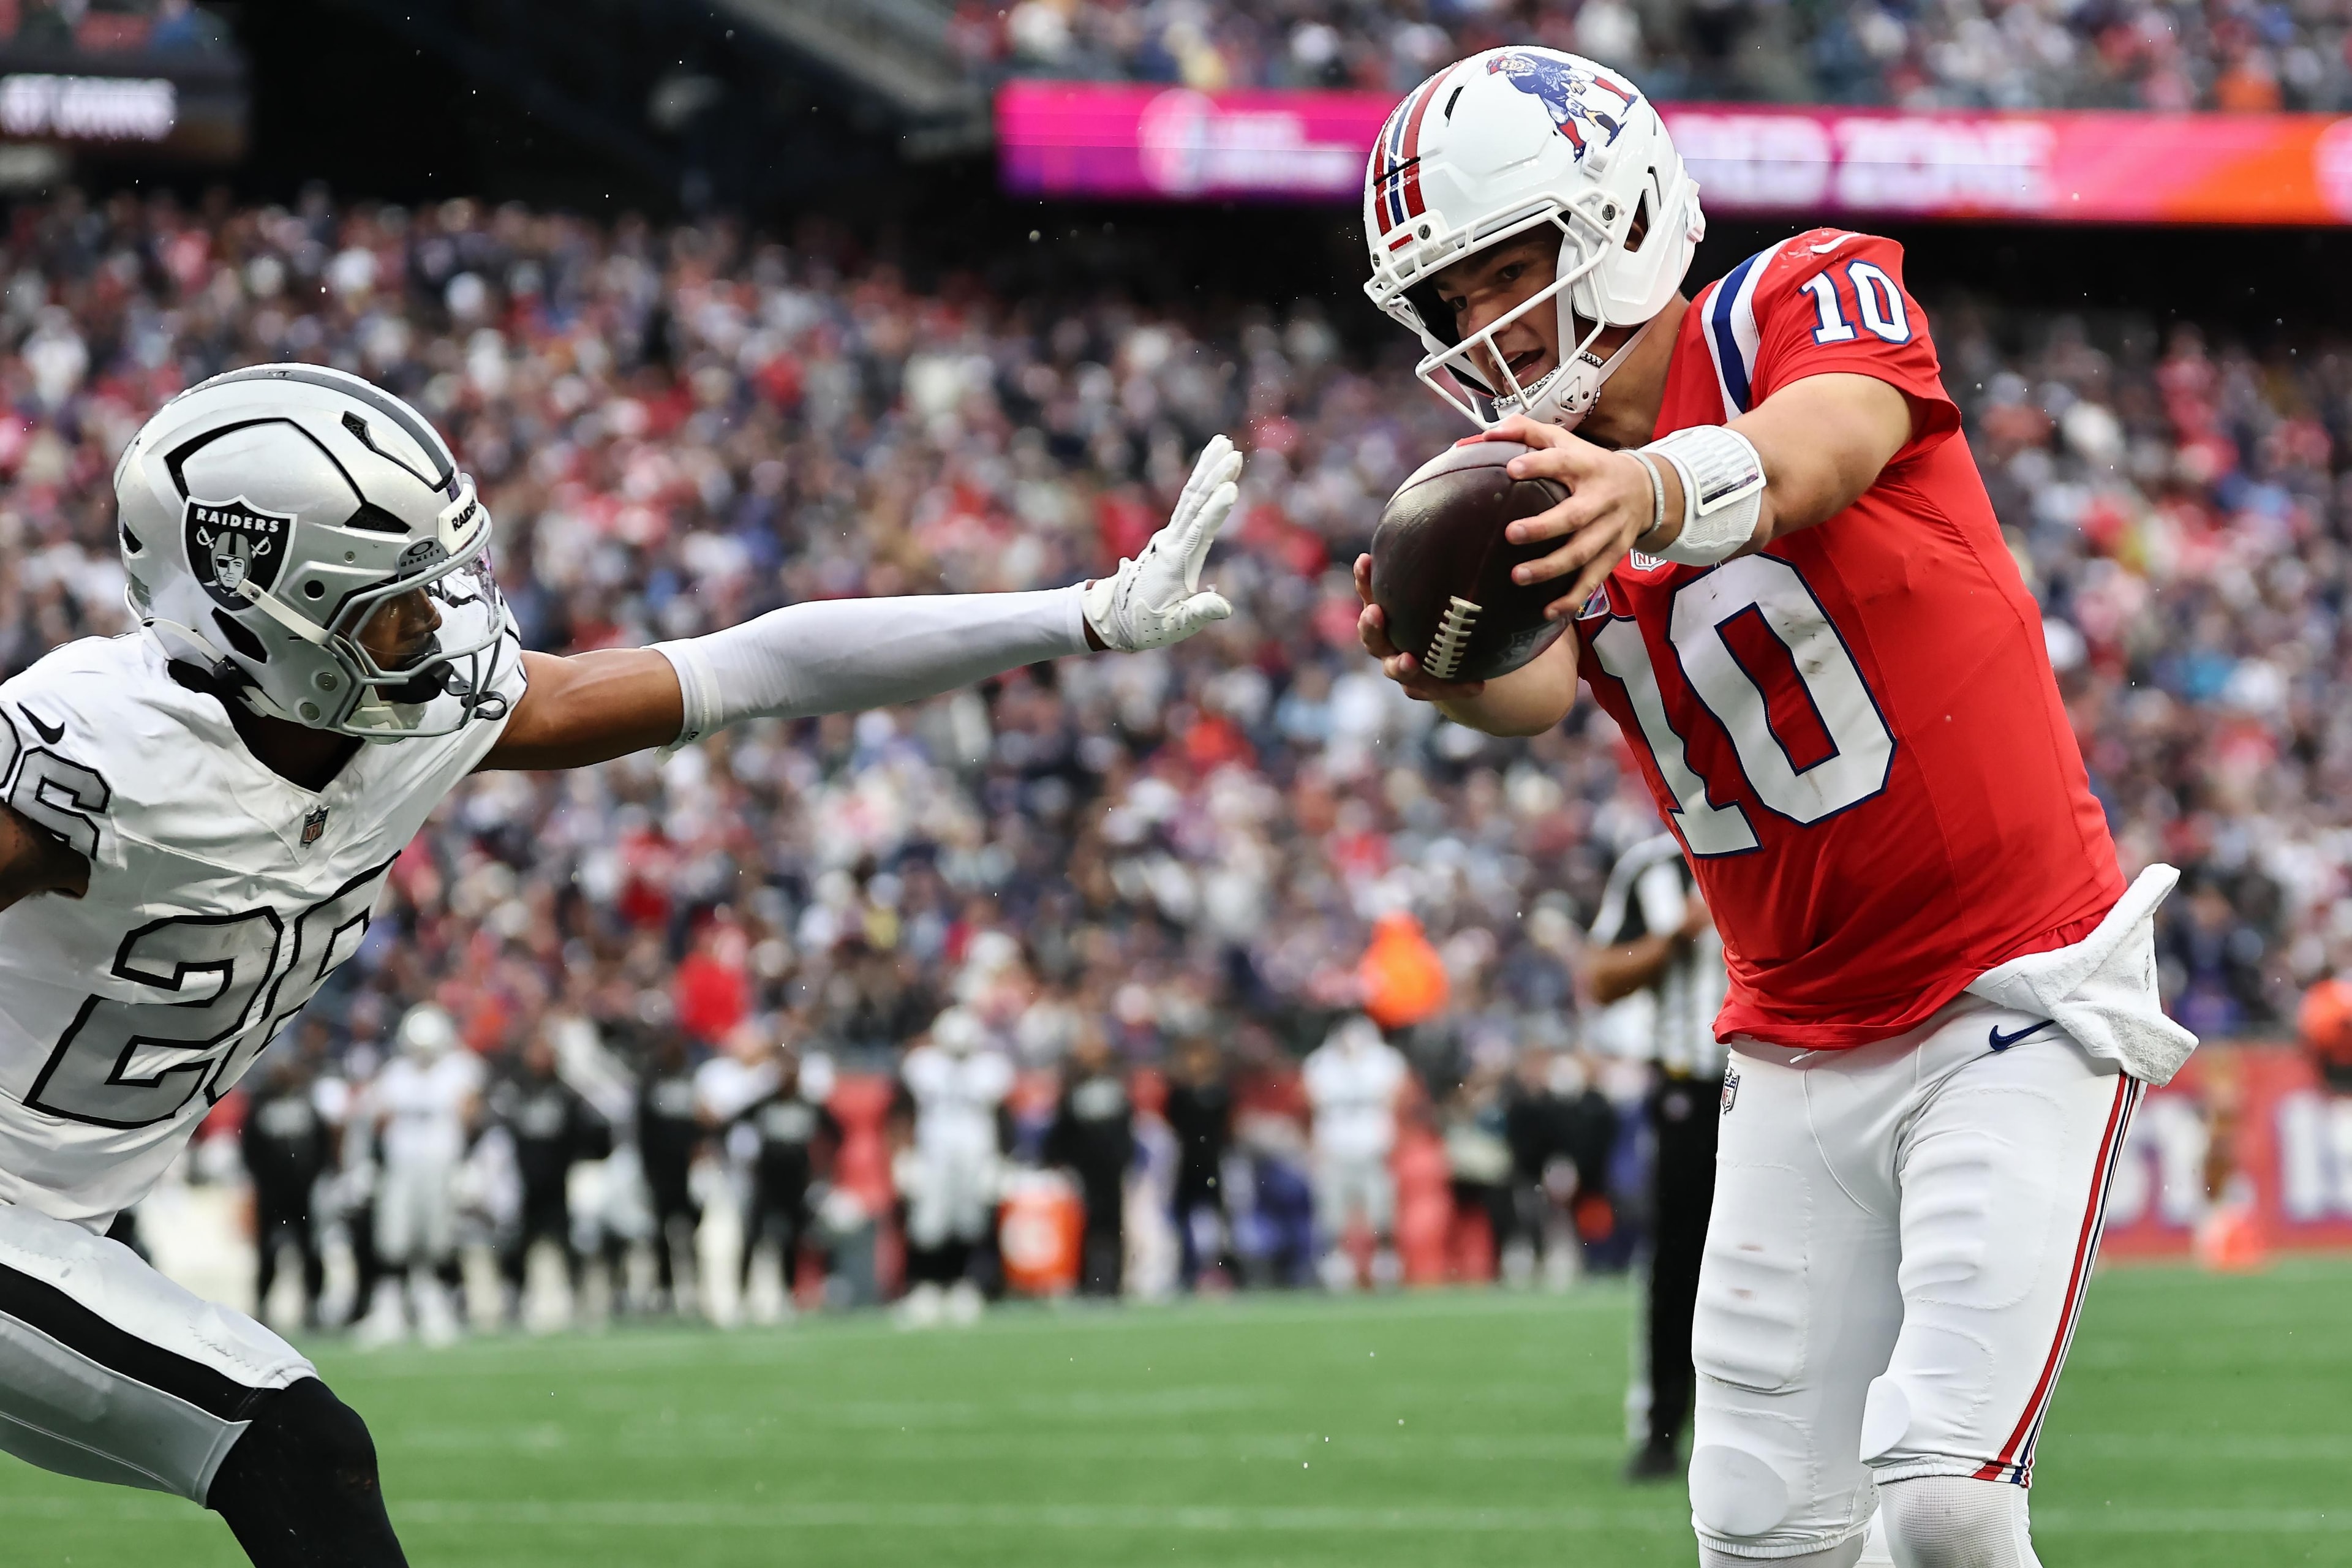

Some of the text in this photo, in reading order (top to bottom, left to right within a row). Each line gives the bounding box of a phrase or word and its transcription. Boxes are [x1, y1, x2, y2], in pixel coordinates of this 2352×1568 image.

[1799, 258, 1913, 345] 10
[195, 508, 279, 533] RAIDERS
[400, 549, 440, 567] OAKLEY
[1591, 551, 1898, 859] 10
[23, 850, 401, 1129] 26
